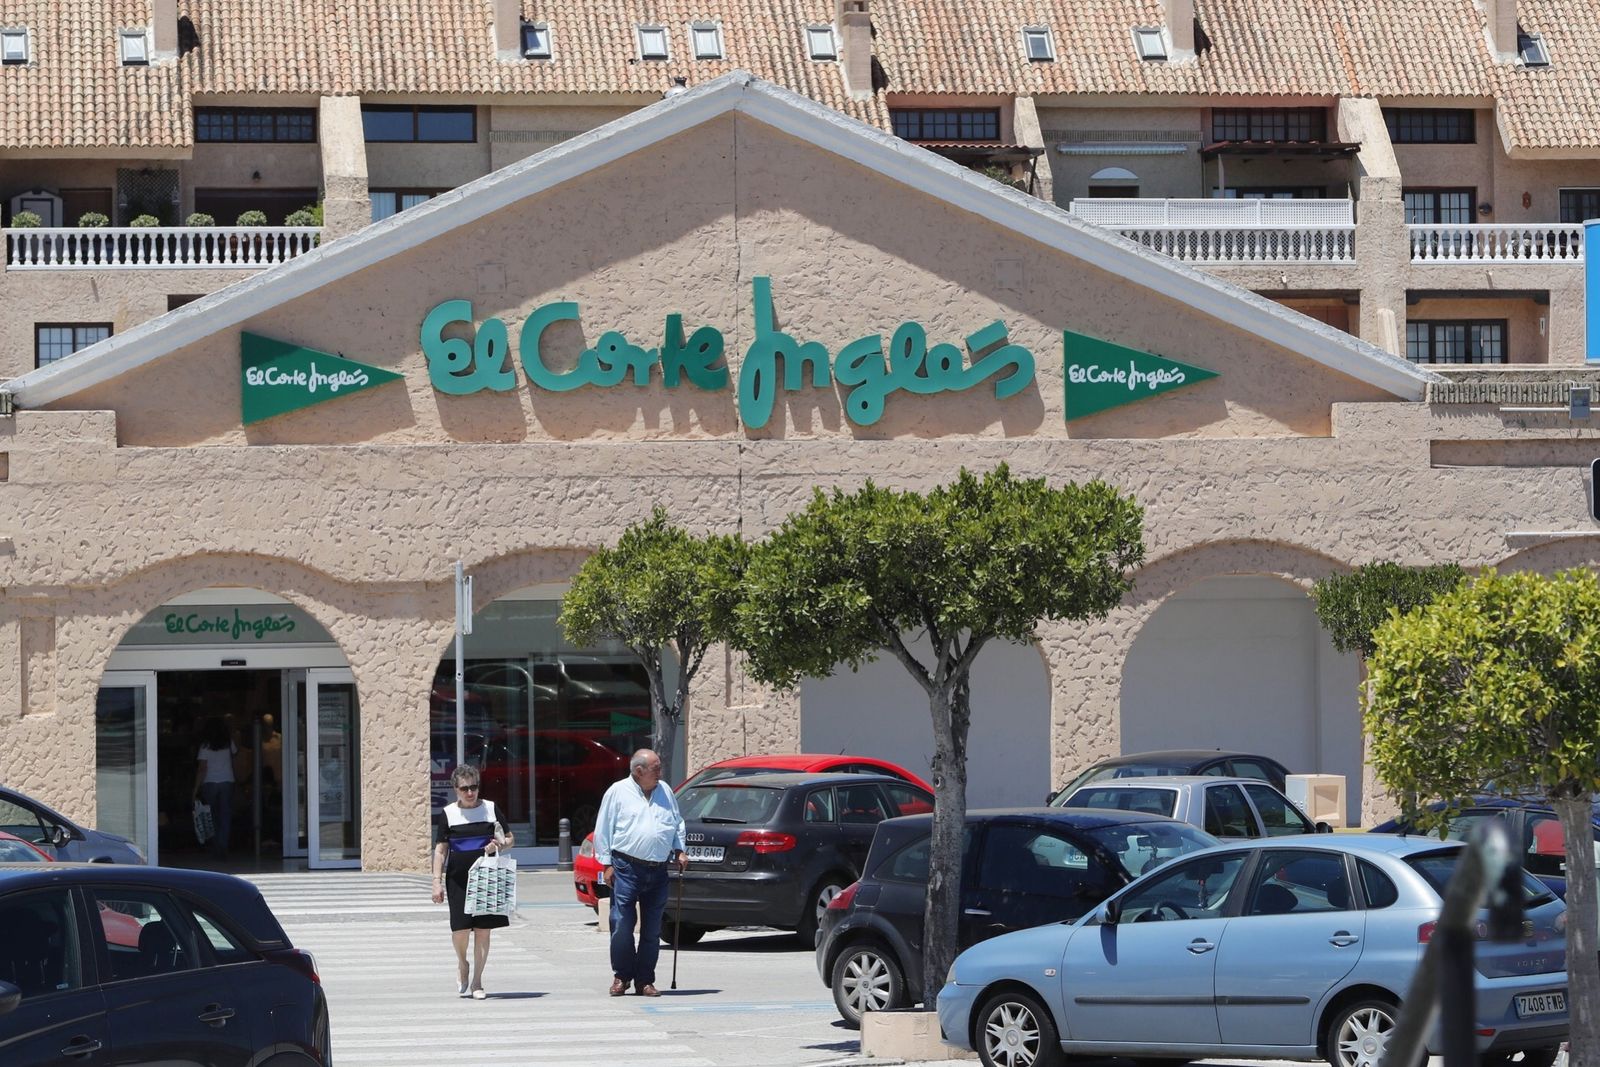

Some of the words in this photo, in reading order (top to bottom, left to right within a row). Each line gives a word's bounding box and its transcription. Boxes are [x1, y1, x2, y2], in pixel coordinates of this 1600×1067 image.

[420, 299, 515, 394] El
[520, 301, 728, 393] Corte
[738, 276, 1035, 429] Inglés
[246, 366, 265, 386] El
[265, 367, 307, 386] Corte
[308, 362, 369, 393] Inglés
[1068, 364, 1086, 383] El
[1087, 365, 1126, 383] Corte
[1128, 360, 1185, 391] Inglés
[165, 613, 184, 633] El
[185, 614, 229, 633] Corte
[232, 608, 295, 640] Inglés
[703, 847, 722, 859] GNG
[1520, 997, 1545, 1013] 7408
[1546, 995, 1563, 1010] FWB
